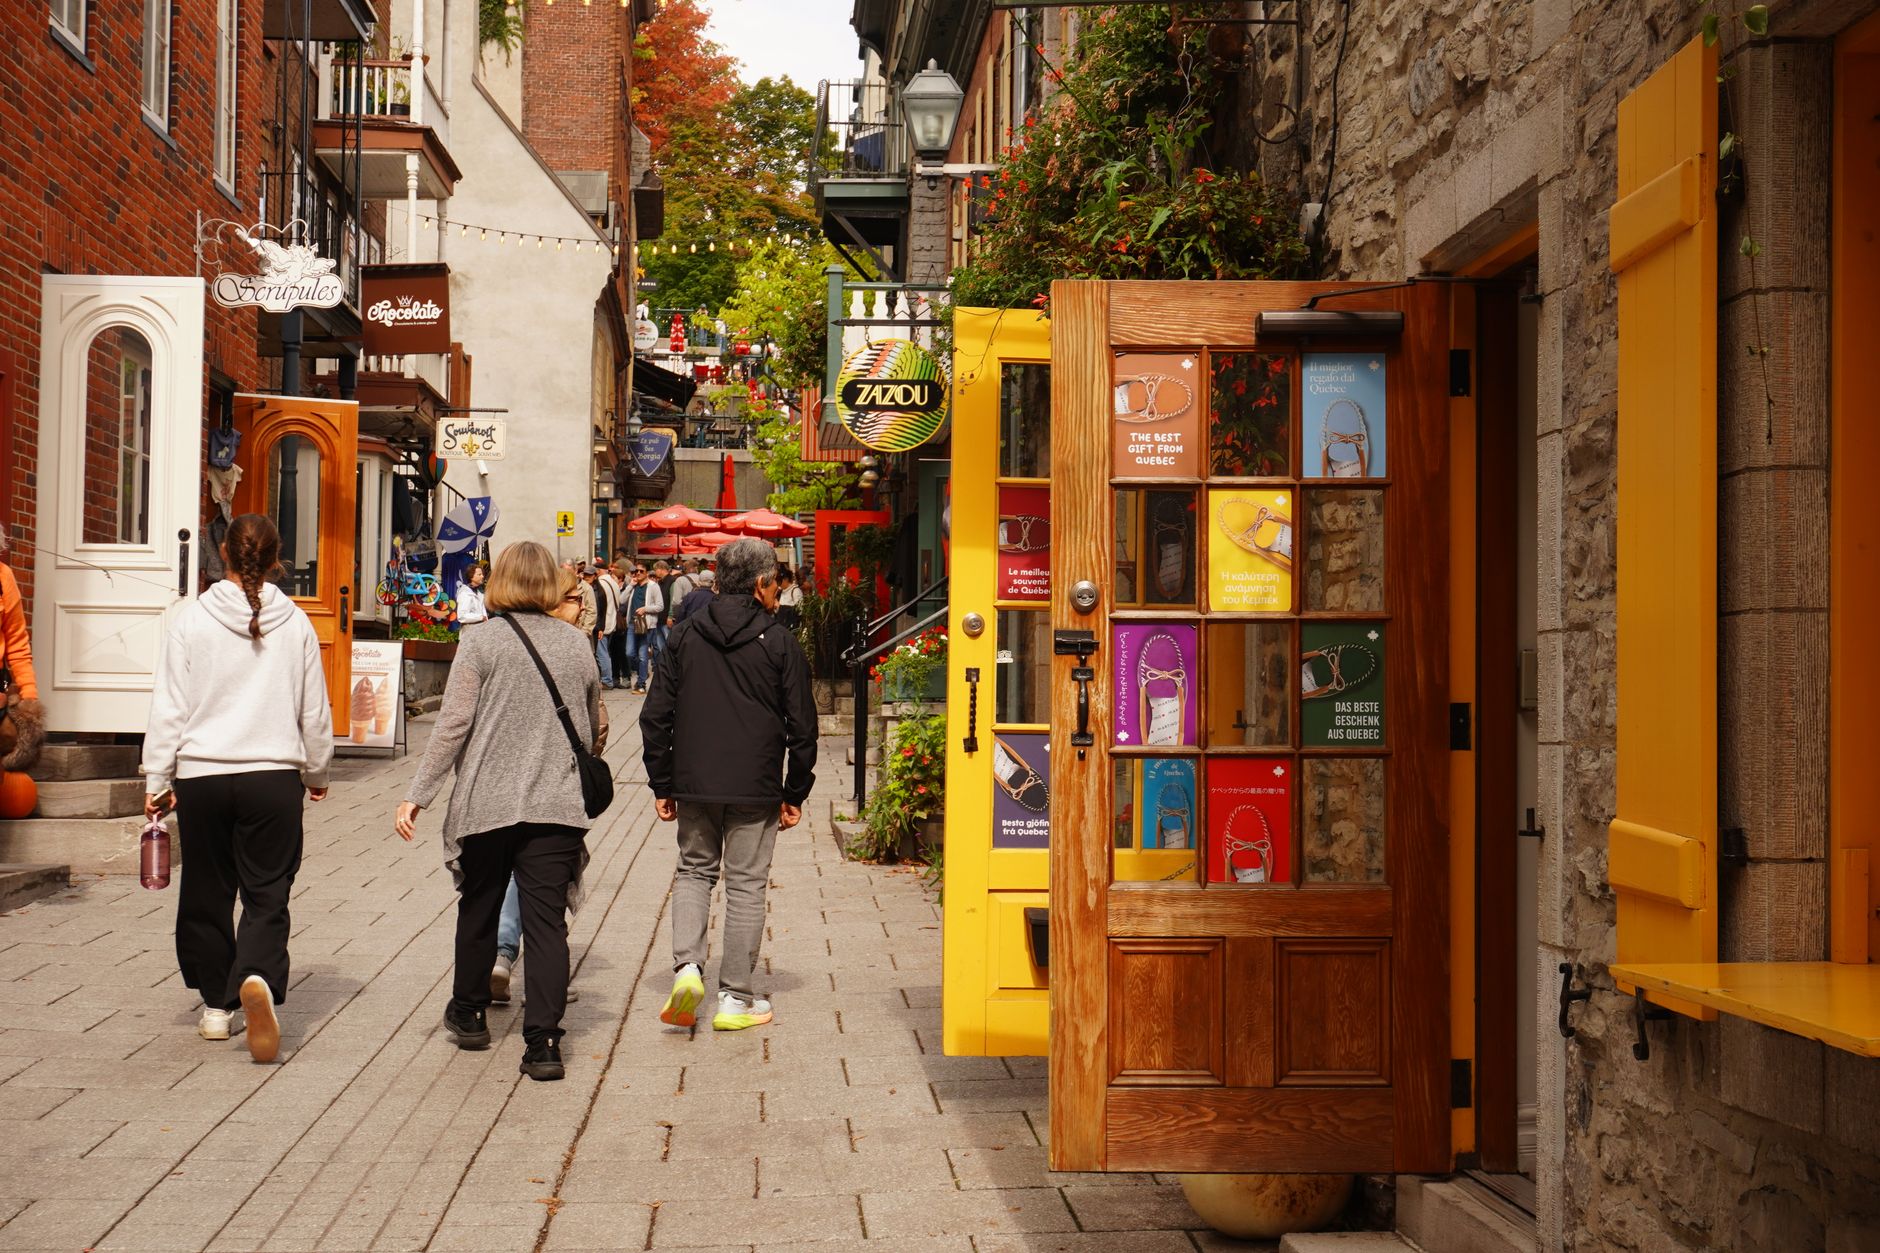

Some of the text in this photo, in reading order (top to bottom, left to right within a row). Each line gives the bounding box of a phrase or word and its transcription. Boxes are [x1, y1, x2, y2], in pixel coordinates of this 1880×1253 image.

[218, 278, 338, 308] Scrupules
[367, 299, 444, 327] Chocolato
[1310, 362, 1352, 373] Il miglior
[1310, 372, 1355, 384] regalo dal
[1310, 384, 1346, 394] Quebec
[854, 384, 928, 406] ZAZOU
[1130, 432, 1181, 442] THE BEST
[1128, 444, 1183, 453] GIFT FROM
[1136, 456, 1175, 465] QUEBEC
[1335, 702, 1379, 712] DAS BESTE
[1335, 715, 1380, 726] GESCHENK
[1328, 729, 1379, 740] AUS QUEBEC
[1026, 819, 1050, 828] gjöfin
